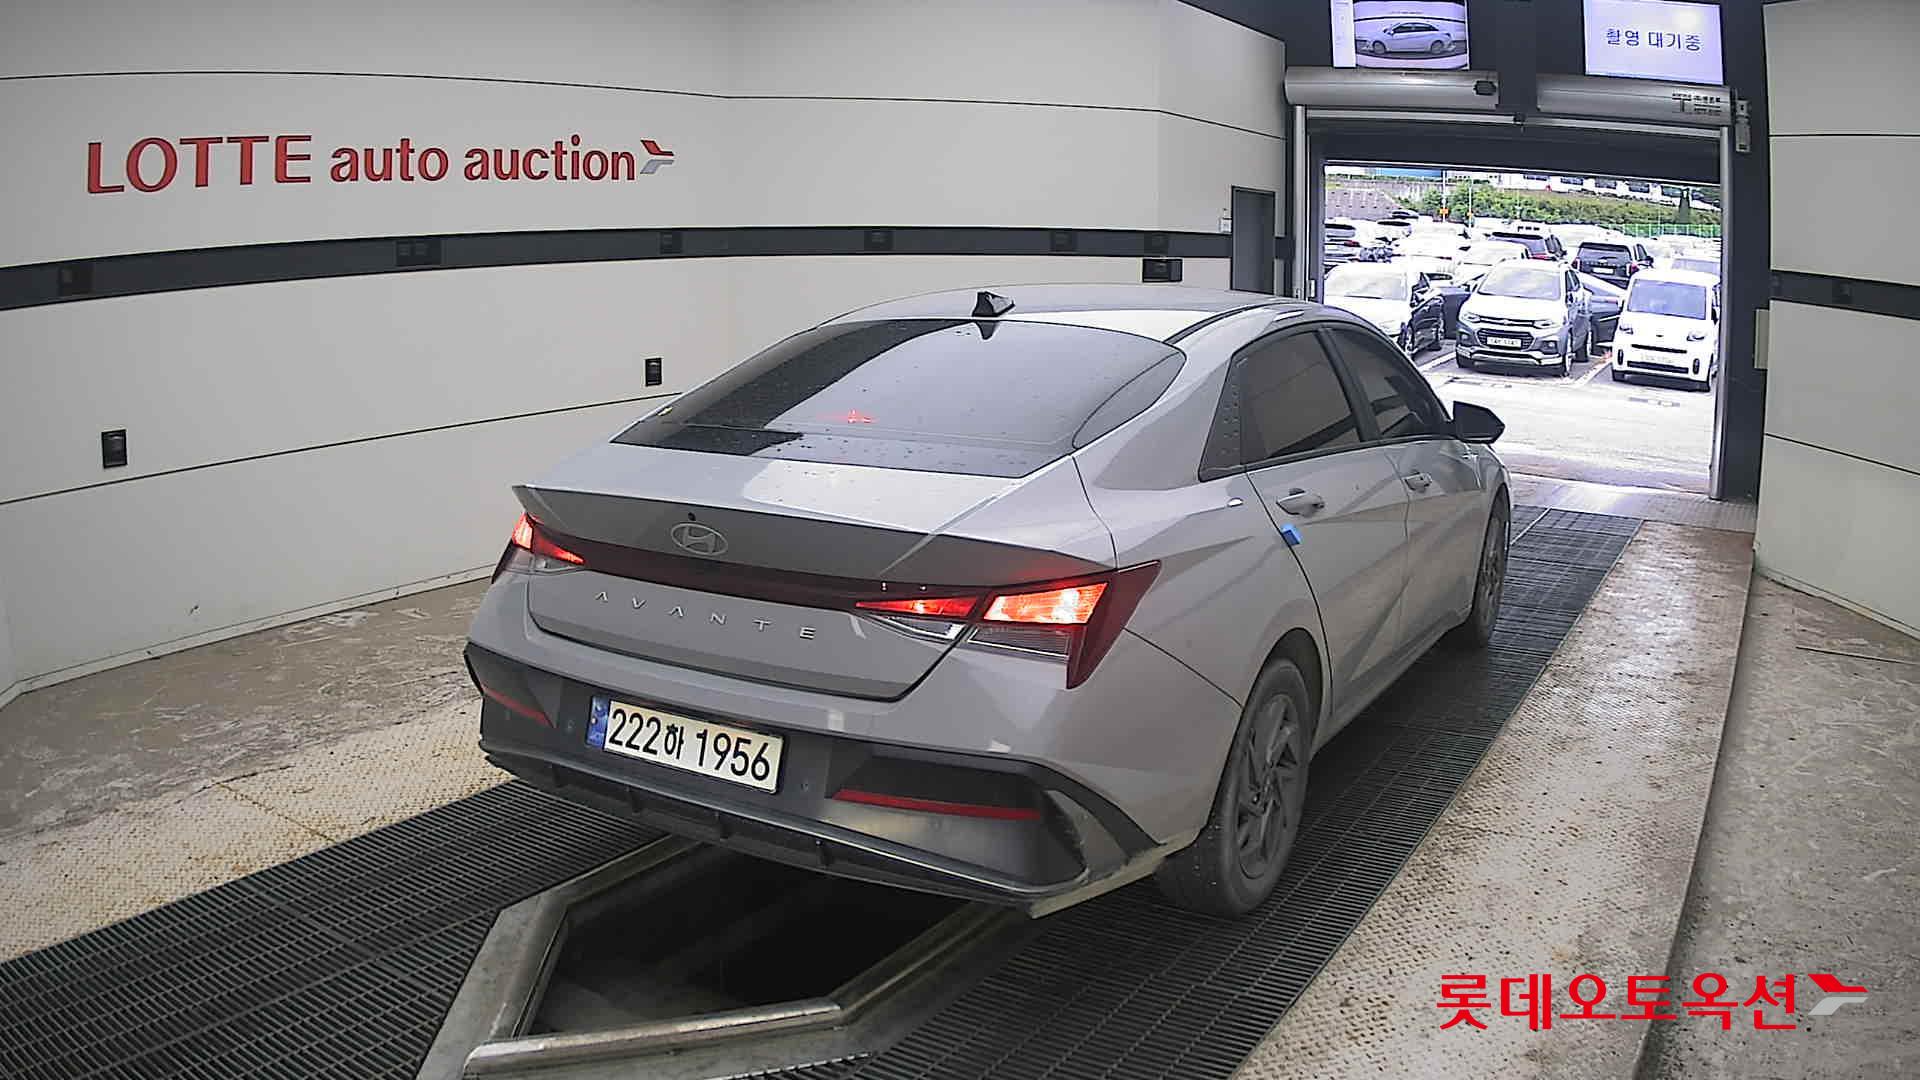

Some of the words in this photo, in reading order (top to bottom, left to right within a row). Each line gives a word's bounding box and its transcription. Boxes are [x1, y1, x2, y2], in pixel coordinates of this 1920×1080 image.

[1607, 28, 1640, 47] 촬영
[1648, 31, 1701, 52] 대기중
[86, 134, 312, 194] LOTTE
[329, 138, 449, 183] auto
[463, 133, 636, 182] auction
[594, 590, 818, 640] AVANTE
[608, 708, 685, 761] 222하
[696, 728, 771, 782] 1956
